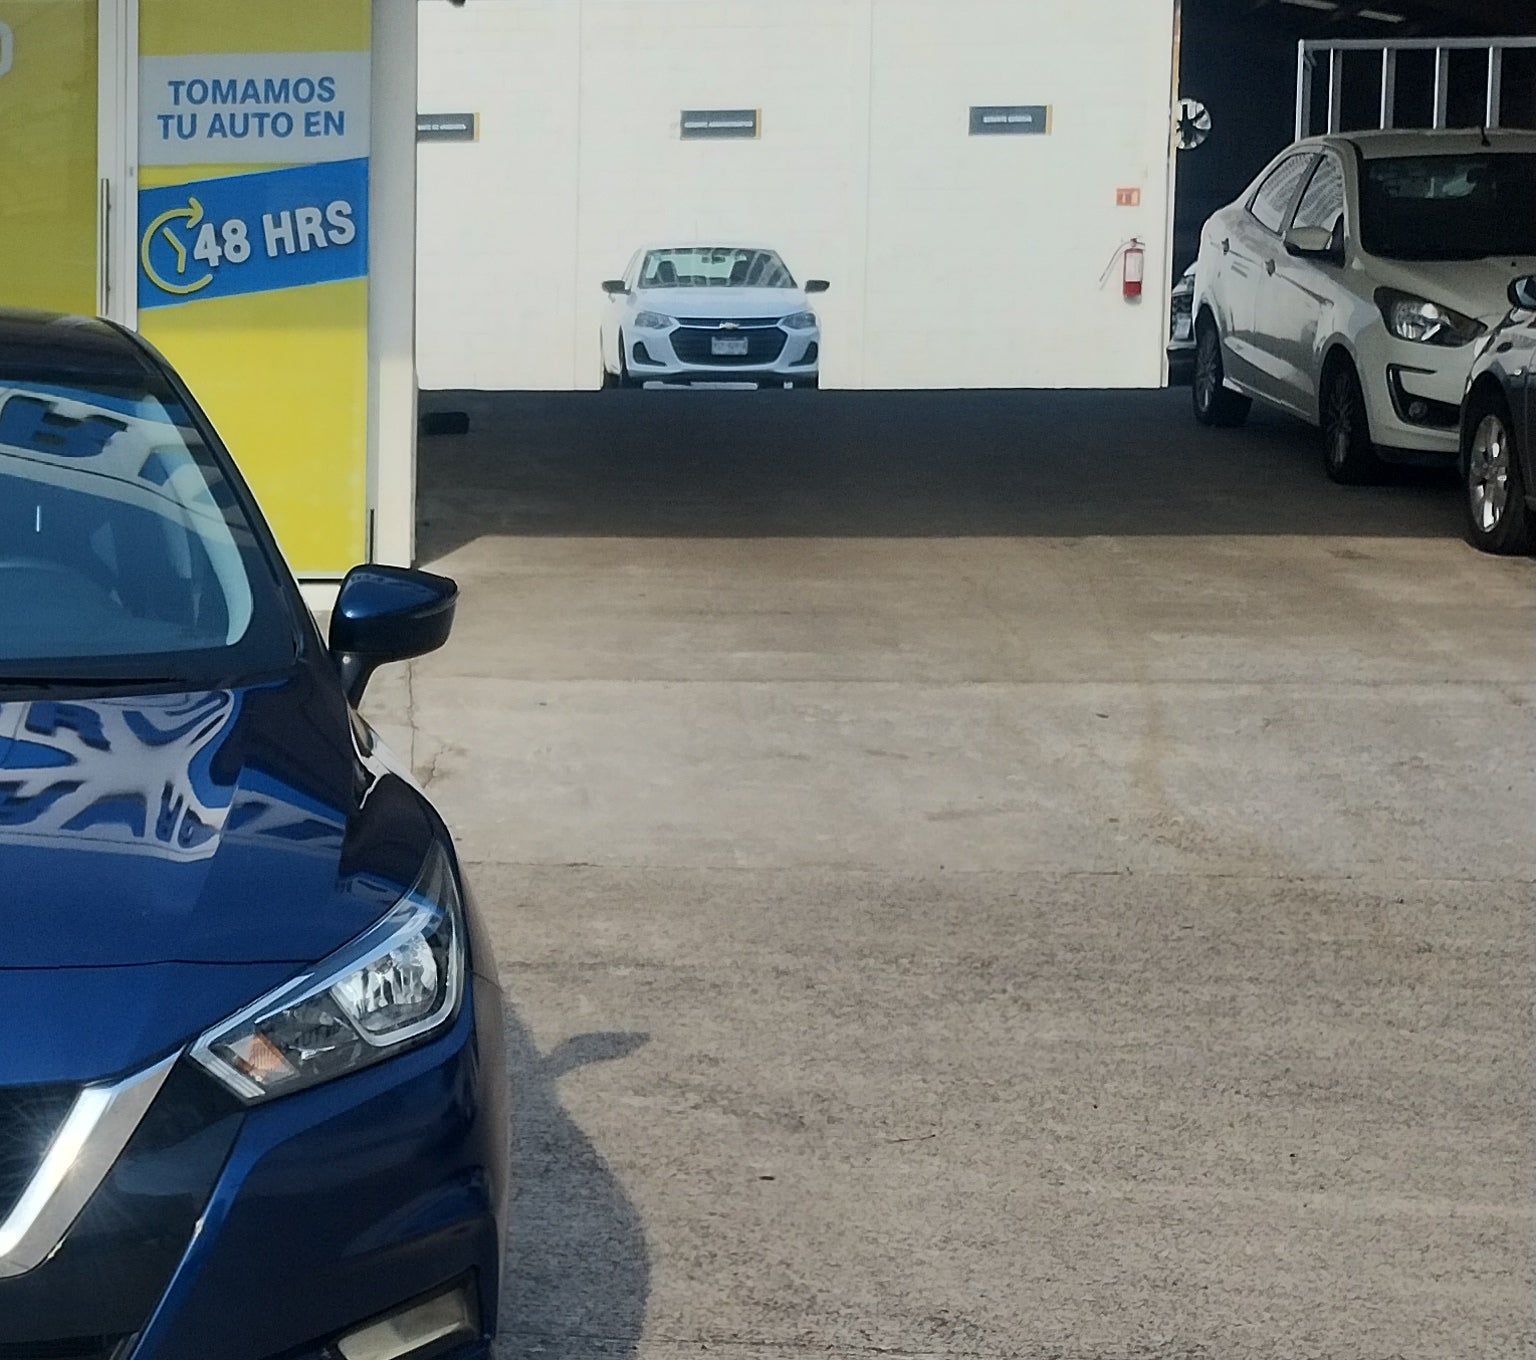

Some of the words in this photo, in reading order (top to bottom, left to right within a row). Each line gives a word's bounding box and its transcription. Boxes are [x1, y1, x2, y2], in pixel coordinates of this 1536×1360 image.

[167, 76, 336, 106] TOMAMOS
[157, 113, 197, 140] TU
[207, 111, 294, 138] AUTO
[304, 110, 345, 137] EN
[193, 218, 252, 268] 48
[262, 200, 357, 258] HRS
